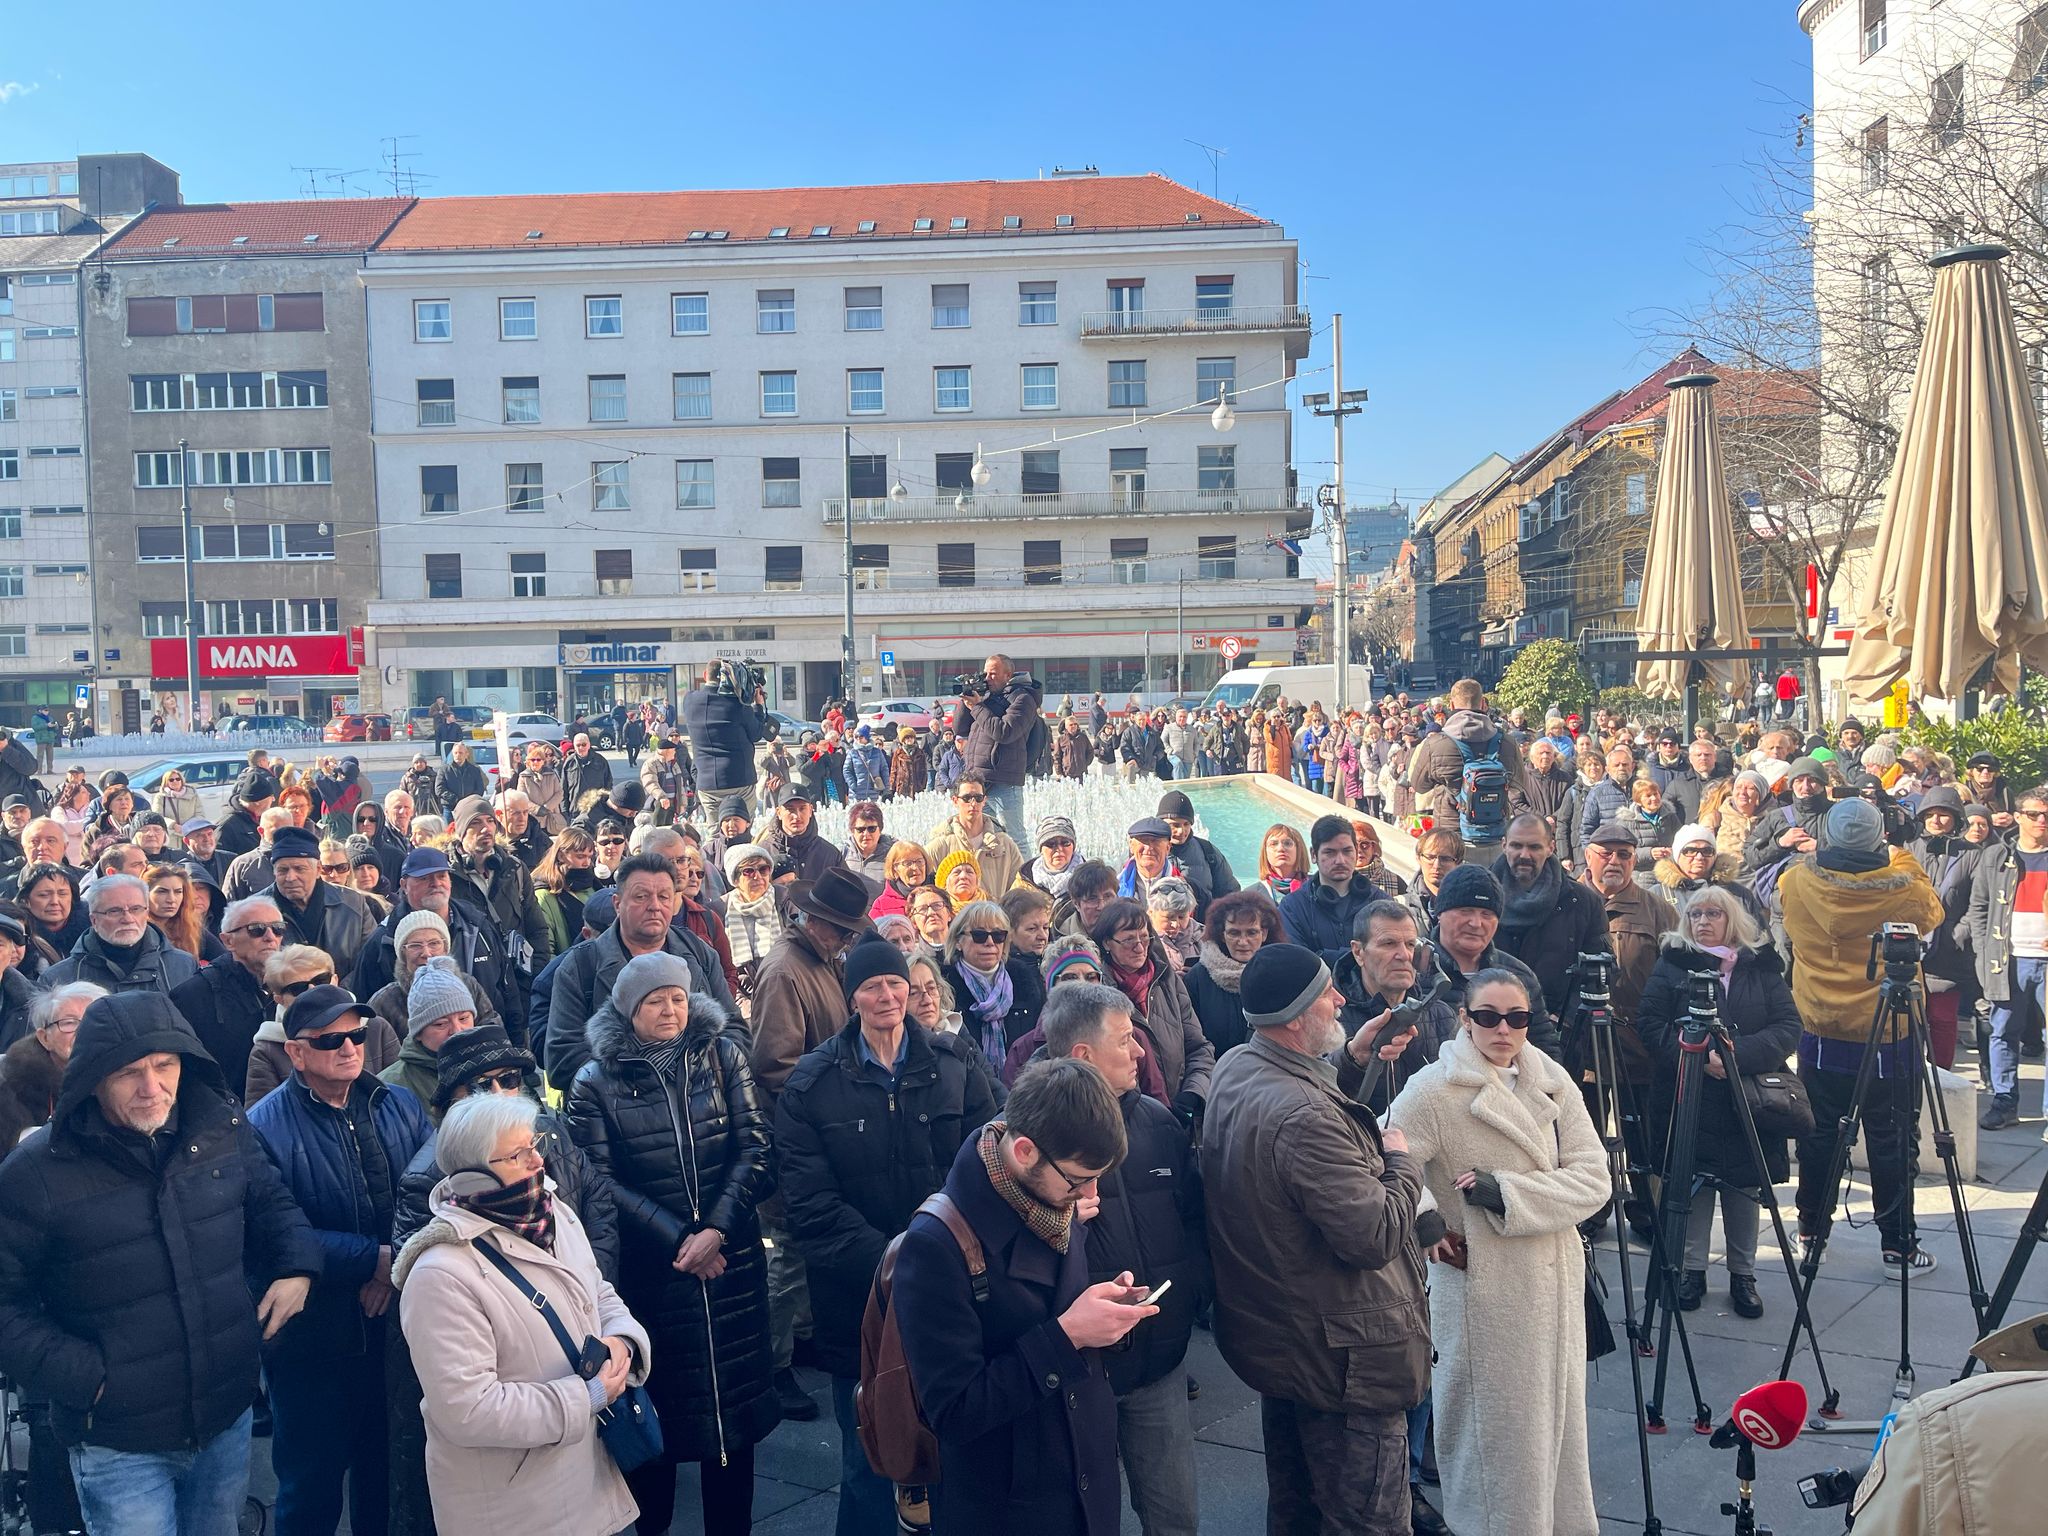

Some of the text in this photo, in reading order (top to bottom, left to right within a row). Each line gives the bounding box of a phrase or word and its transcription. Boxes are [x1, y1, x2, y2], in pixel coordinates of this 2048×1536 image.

[210, 645, 297, 669] MANA
[591, 641, 661, 663] mlinar
[884, 654, 891, 664] P
[79, 687, 86, 698] P
